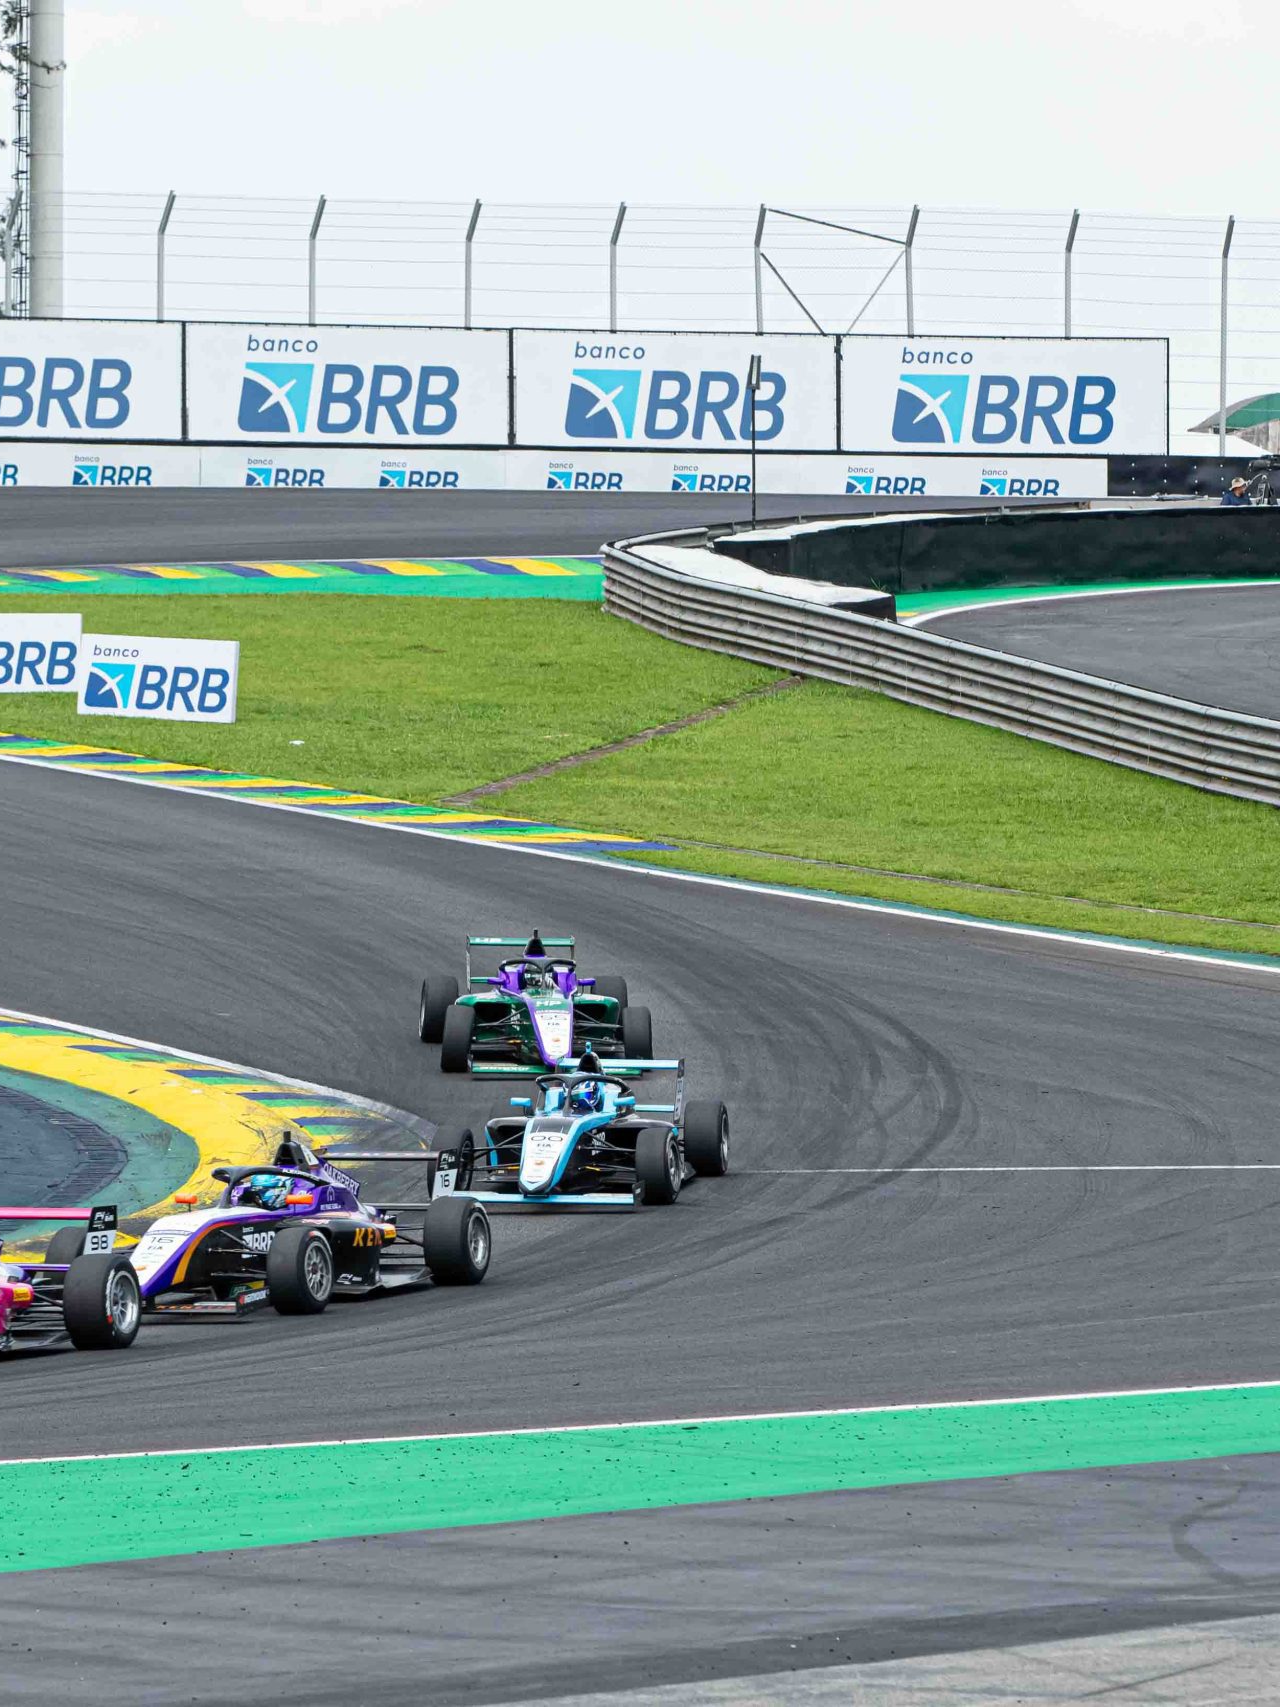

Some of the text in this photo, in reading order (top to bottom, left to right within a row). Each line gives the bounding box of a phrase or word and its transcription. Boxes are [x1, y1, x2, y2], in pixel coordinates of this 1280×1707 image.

[247, 334, 319, 353] banco
[574, 341, 646, 360] banco
[901, 346, 974, 365] banco
[319, 363, 460, 436] BRB
[643, 370, 786, 441] BRB
[970, 374, 1117, 445] BRB
[381, 460, 407, 468] banco
[673, 464, 699, 472] banco
[847, 466, 874, 474] banco
[982, 468, 1008, 476] banco
[93, 644, 140, 658] banco
[135, 664, 230, 714] BRB
[323, 1162, 360, 1196] OAKBERRY
[440, 1173, 450, 1188] 16
[90, 1235, 109, 1250] 98
